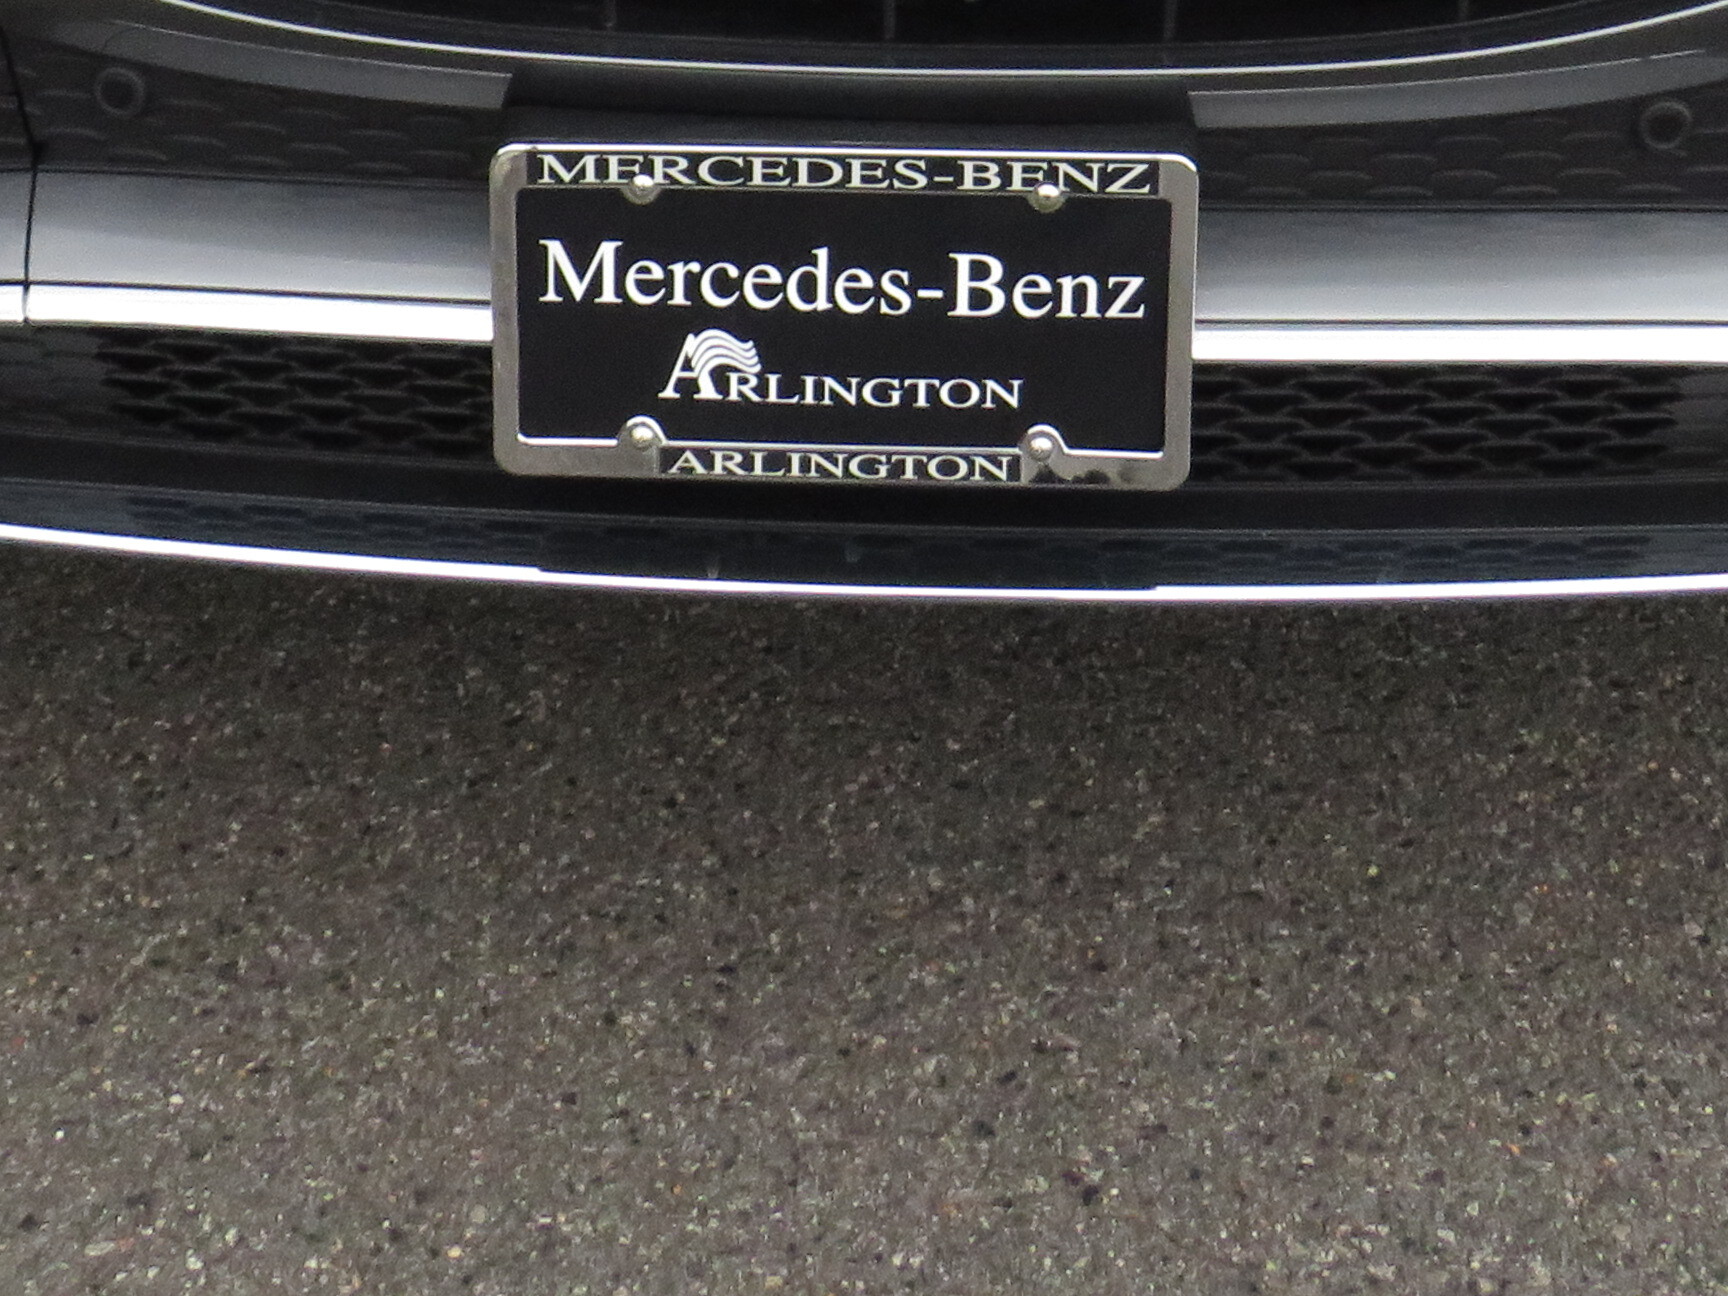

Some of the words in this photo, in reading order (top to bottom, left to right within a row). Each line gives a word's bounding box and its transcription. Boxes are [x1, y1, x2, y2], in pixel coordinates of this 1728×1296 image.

[538, 154, 1152, 194] MERCEDES-BENZ
[539, 238, 1146, 320] Mercedes-Benz
[659, 328, 1024, 410] ARLINGTON
[668, 448, 1012, 483] ARLINGTON
